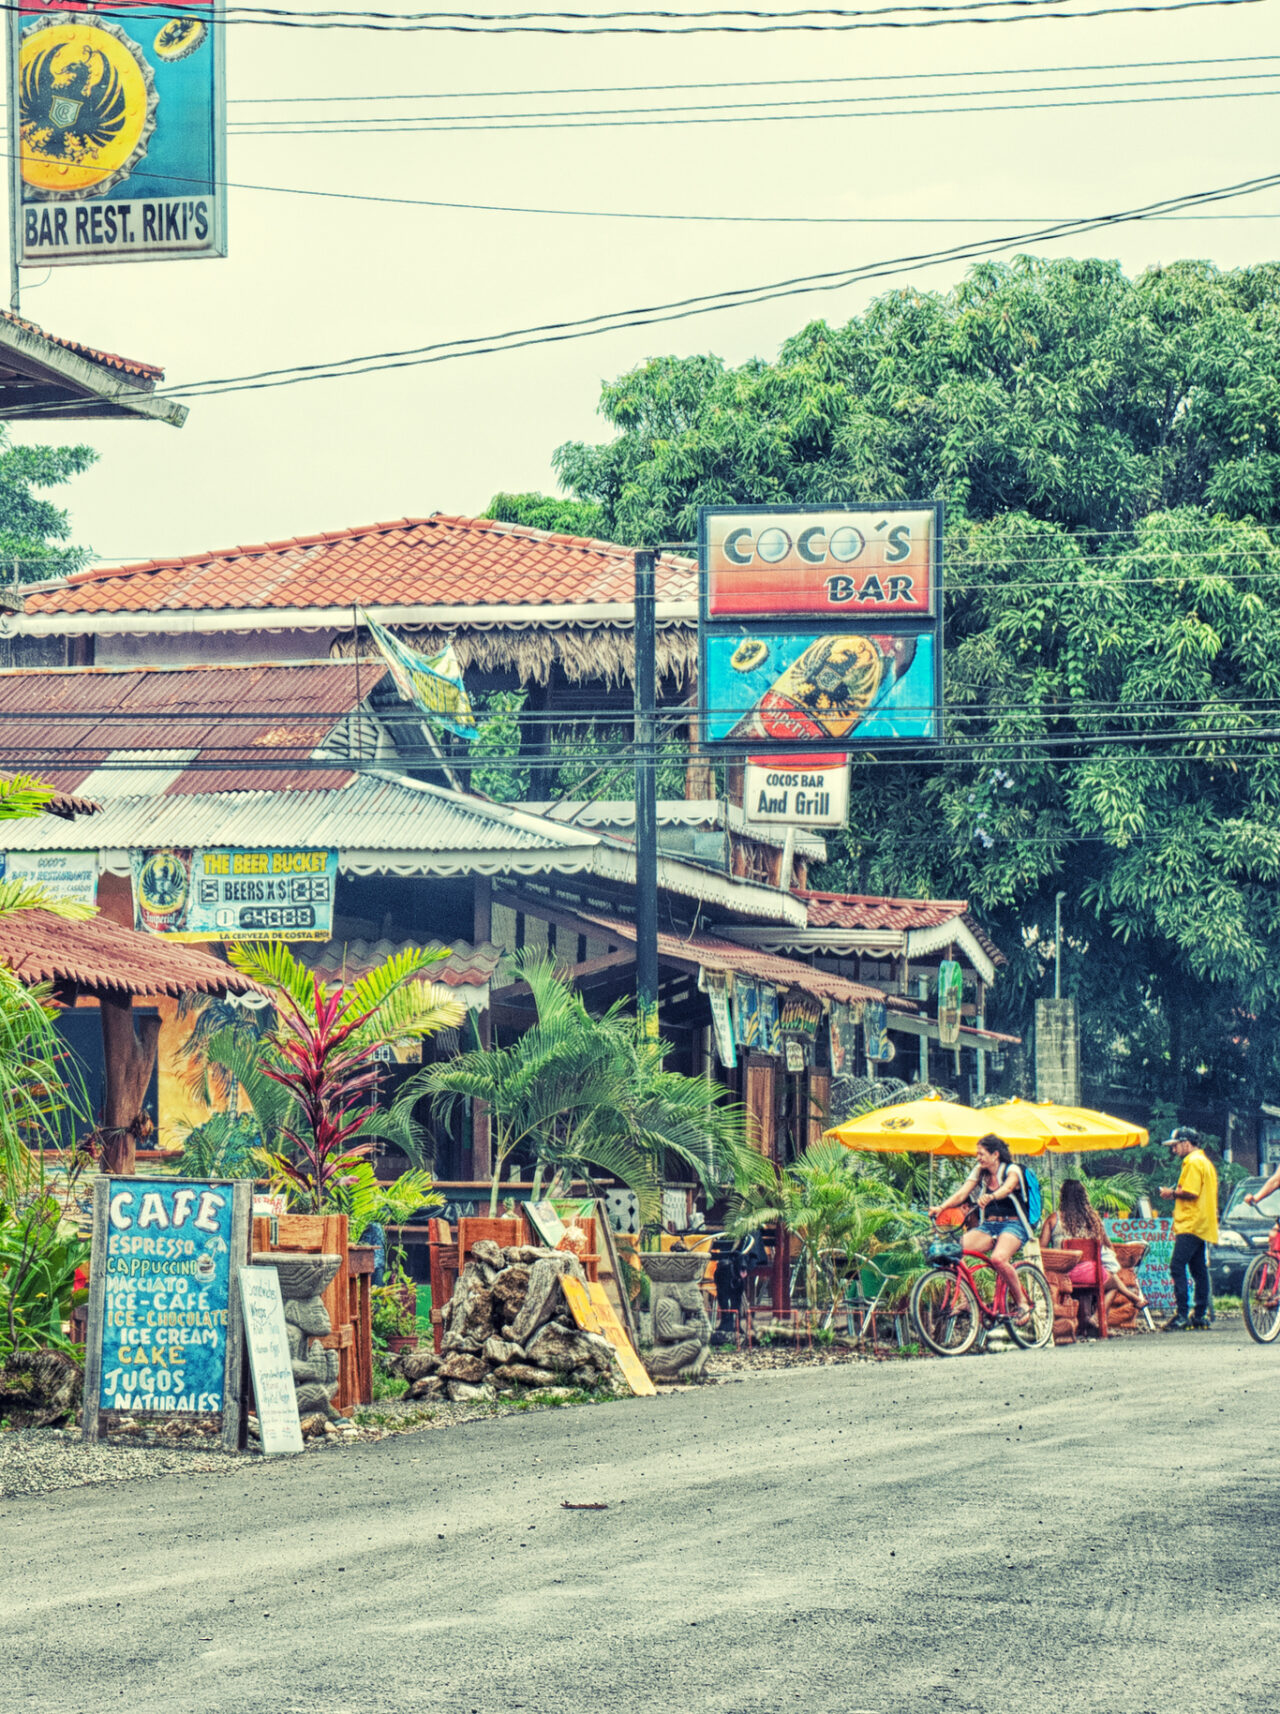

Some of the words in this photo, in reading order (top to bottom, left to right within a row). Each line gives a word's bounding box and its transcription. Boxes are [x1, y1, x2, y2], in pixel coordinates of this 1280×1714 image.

[25, 207, 68, 247] BAR
[76, 204, 134, 244] REST.
[143, 201, 208, 242] RIKI'S
[723, 520, 912, 565] COCO'S
[825, 574, 918, 603] BAR
[766, 774, 798, 788] COCOS
[800, 774, 824, 788] BAR
[758, 791, 787, 814] And
[795, 792, 830, 816] Grill
[203, 854, 231, 875] THE
[233, 853, 269, 875] BEER
[272, 852, 328, 874] BUCKET
[224, 880, 264, 901] BEERS
[267, 881, 276, 901] X
[220, 932, 231, 940] LA
[232, 932, 269, 940] CERVEZA
[272, 931, 283, 939] DE
[285, 931, 312, 939] COSTA
[1112, 1220, 1156, 1233] COCOS
[109, 1234, 194, 1259] ESPRESSO
[107, 1257, 197, 1277] CAPPUCCINO
[106, 1275, 188, 1293] MACCIATO
[120, 1328, 151, 1344] ICE
[156, 1328, 218, 1348] CREAM
[118, 1345, 186, 1368] CAKE
[105, 1367, 185, 1395] JUGOS
[115, 1392, 220, 1410] NATURALES
